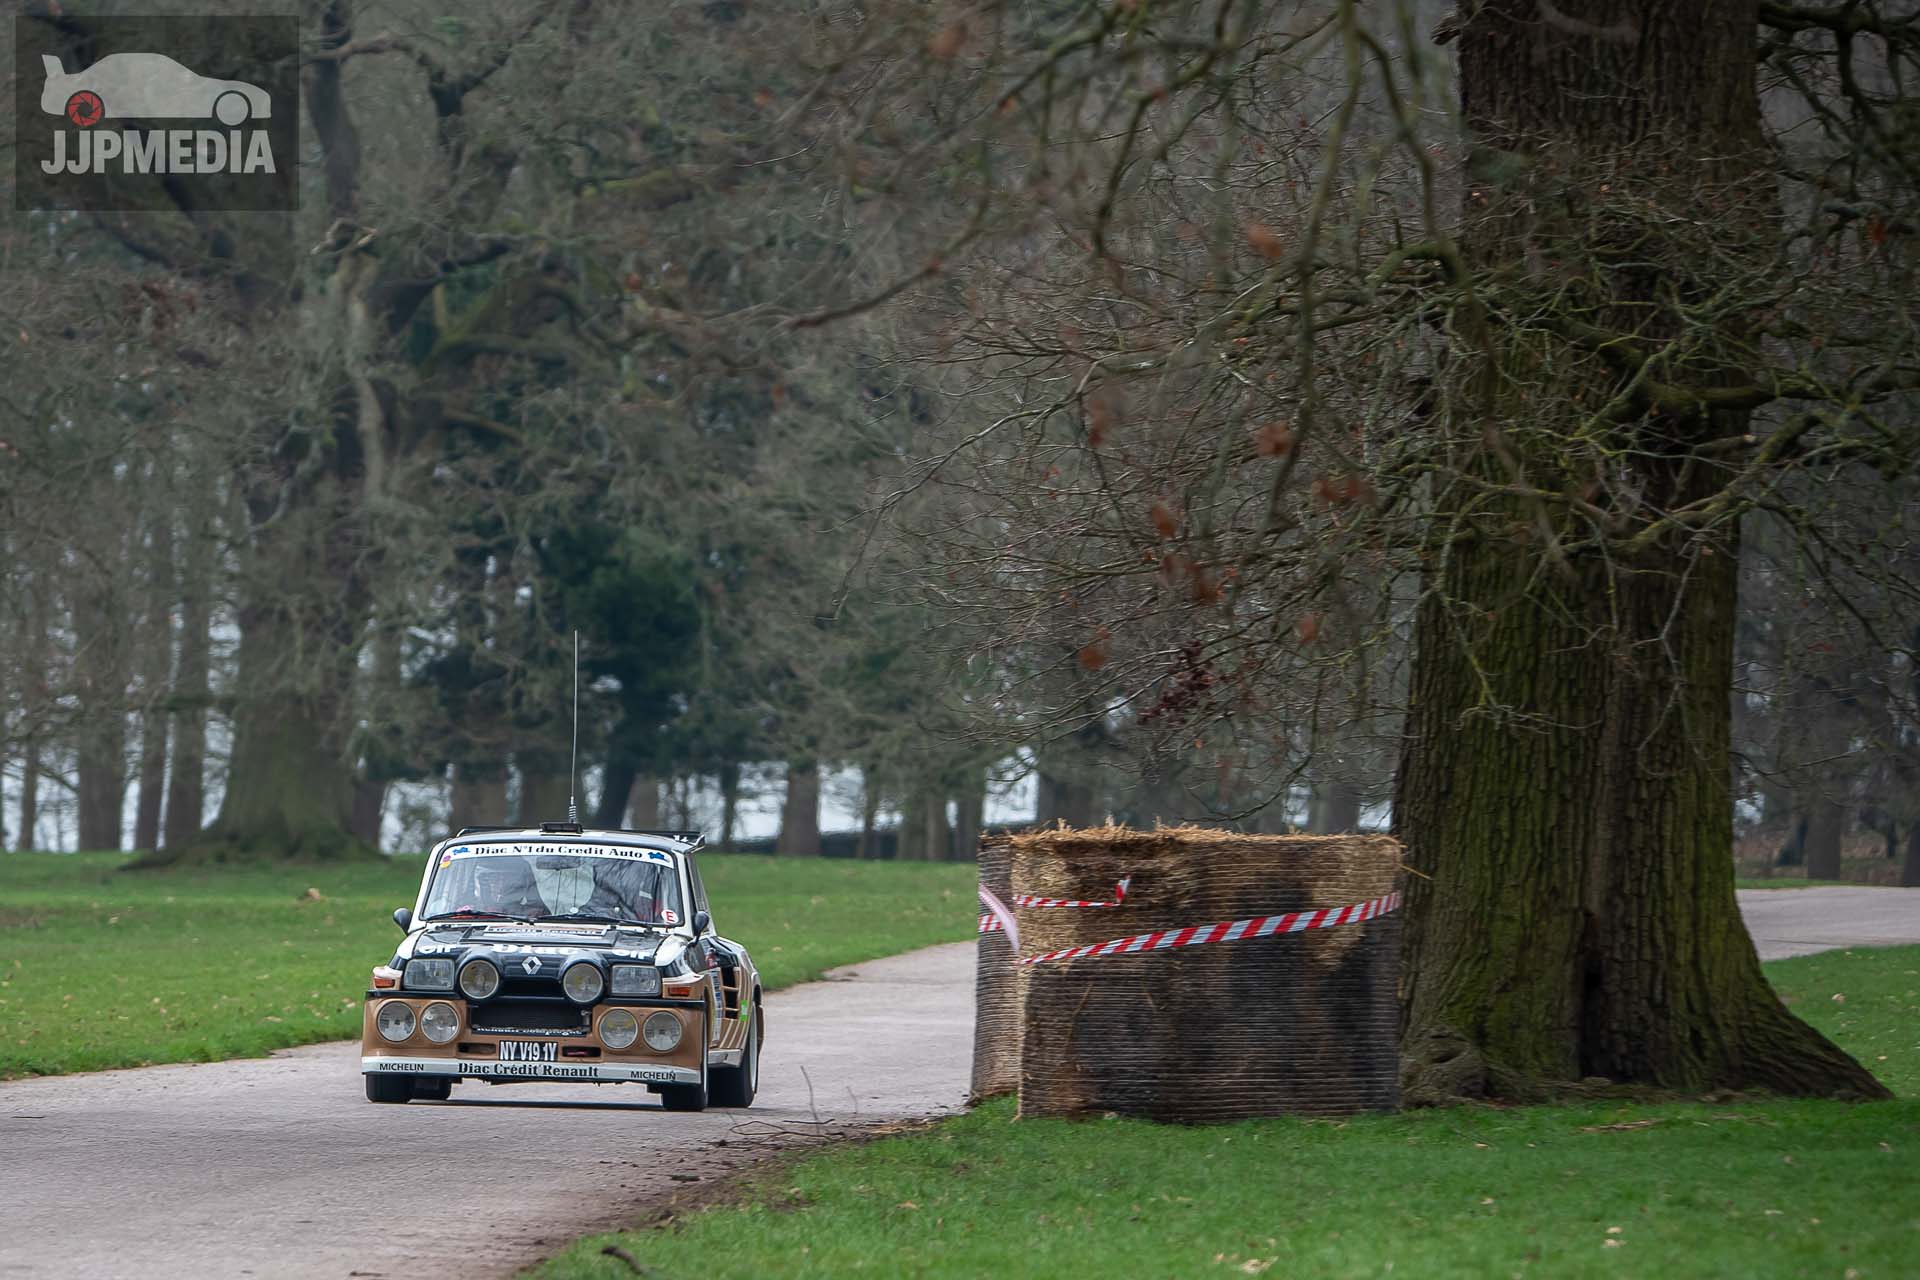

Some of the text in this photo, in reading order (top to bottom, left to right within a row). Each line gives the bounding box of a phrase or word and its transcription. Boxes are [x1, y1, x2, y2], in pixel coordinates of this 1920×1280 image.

[475, 846, 508, 855] Diac
[536, 845, 554, 855] du
[608, 848, 644, 859] Auto
[666, 911, 675, 922] E
[500, 1041, 518, 1061] NY
[379, 1063, 424, 1071] MICHELIN
[458, 1063, 599, 1077] Diac Crédit Renault
[630, 1070, 676, 1080] MICHELIN
